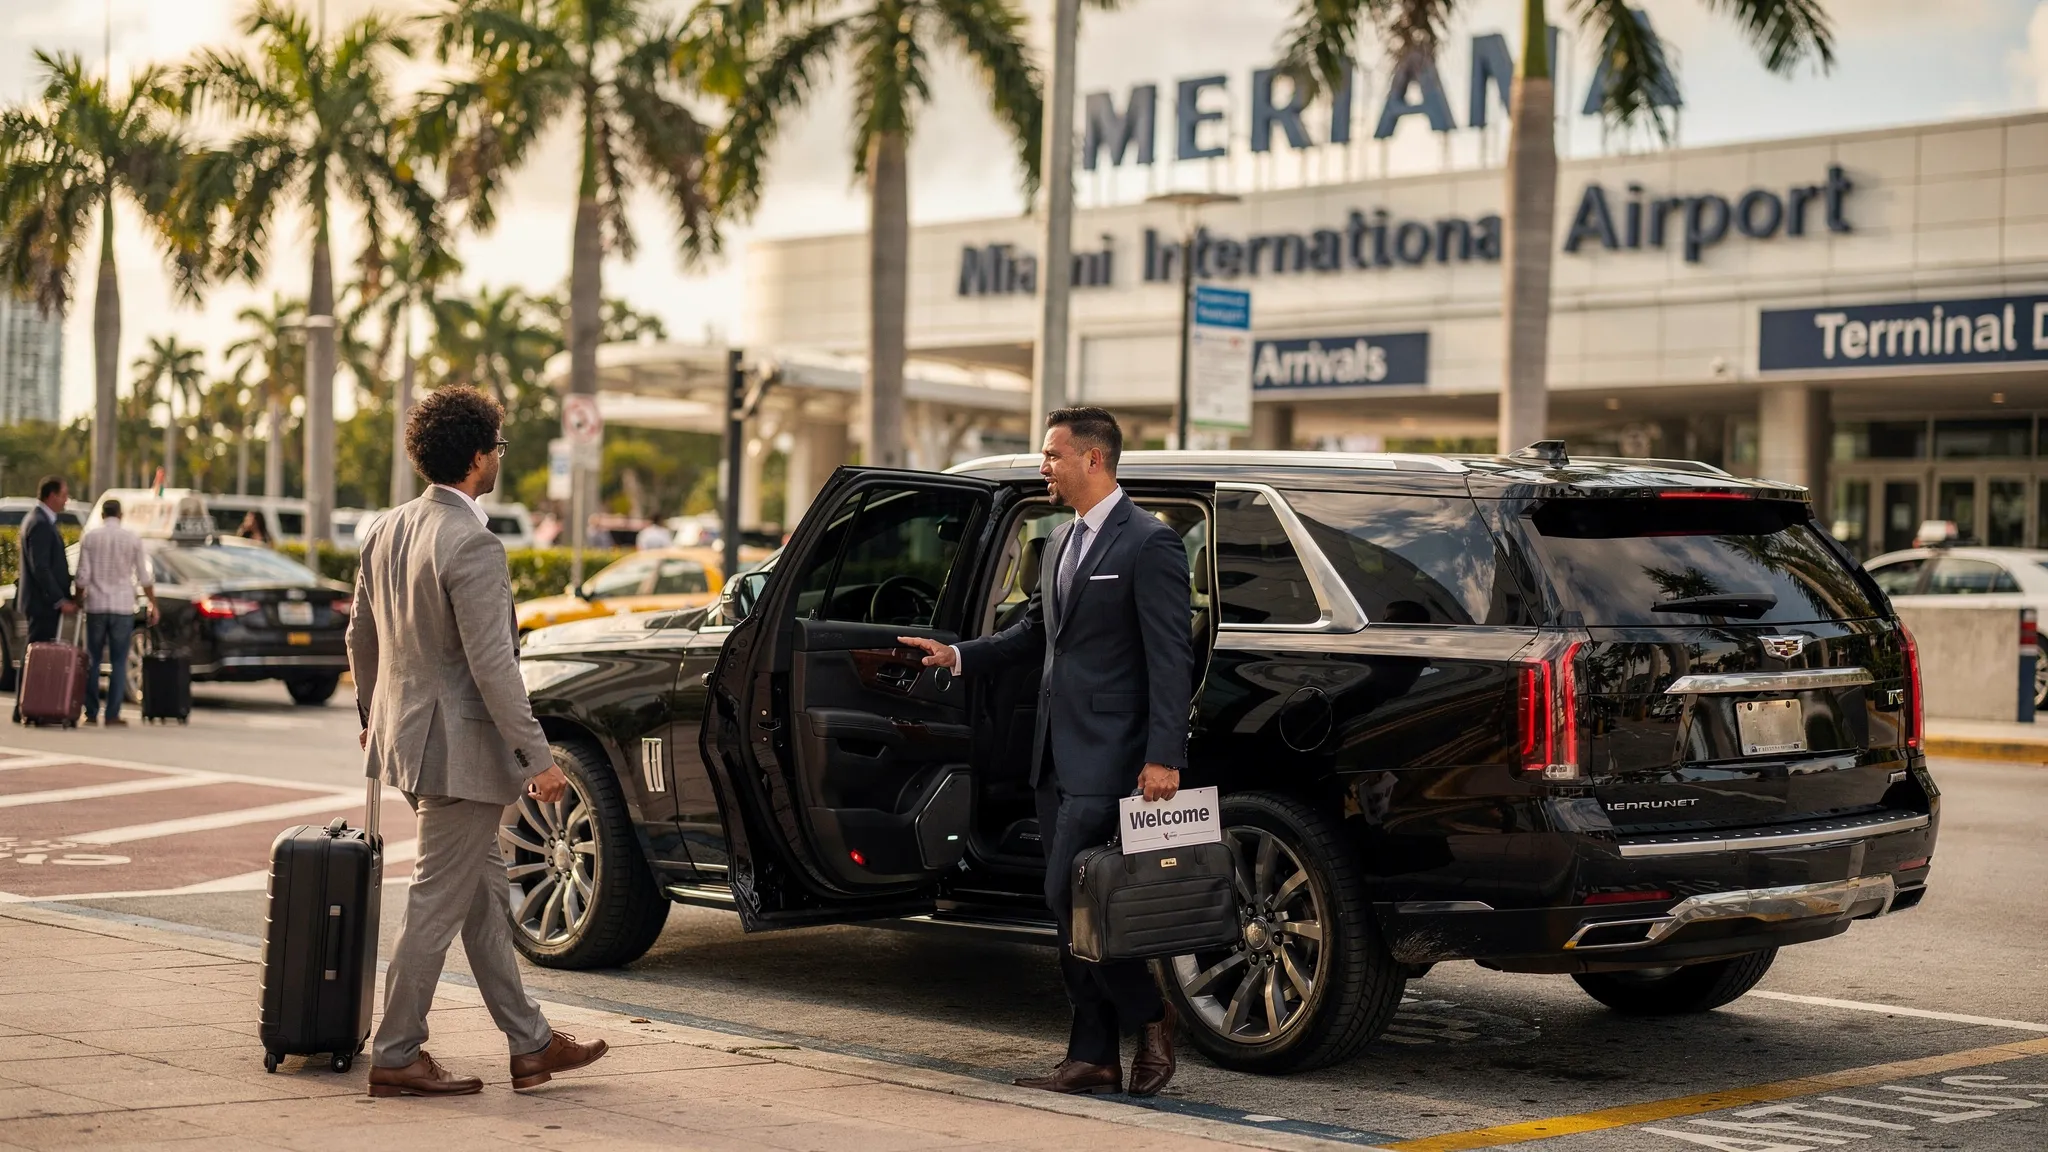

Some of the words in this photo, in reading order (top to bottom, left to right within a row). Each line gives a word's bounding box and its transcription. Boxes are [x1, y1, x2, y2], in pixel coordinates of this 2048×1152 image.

[1144, 207, 1502, 281] Internationa
[1564, 163, 1854, 263] Airport
[1814, 304, 2018, 359] Terminal
[1254, 338, 1388, 386] Arrivals
[1129, 807, 1210, 830] Welcome
